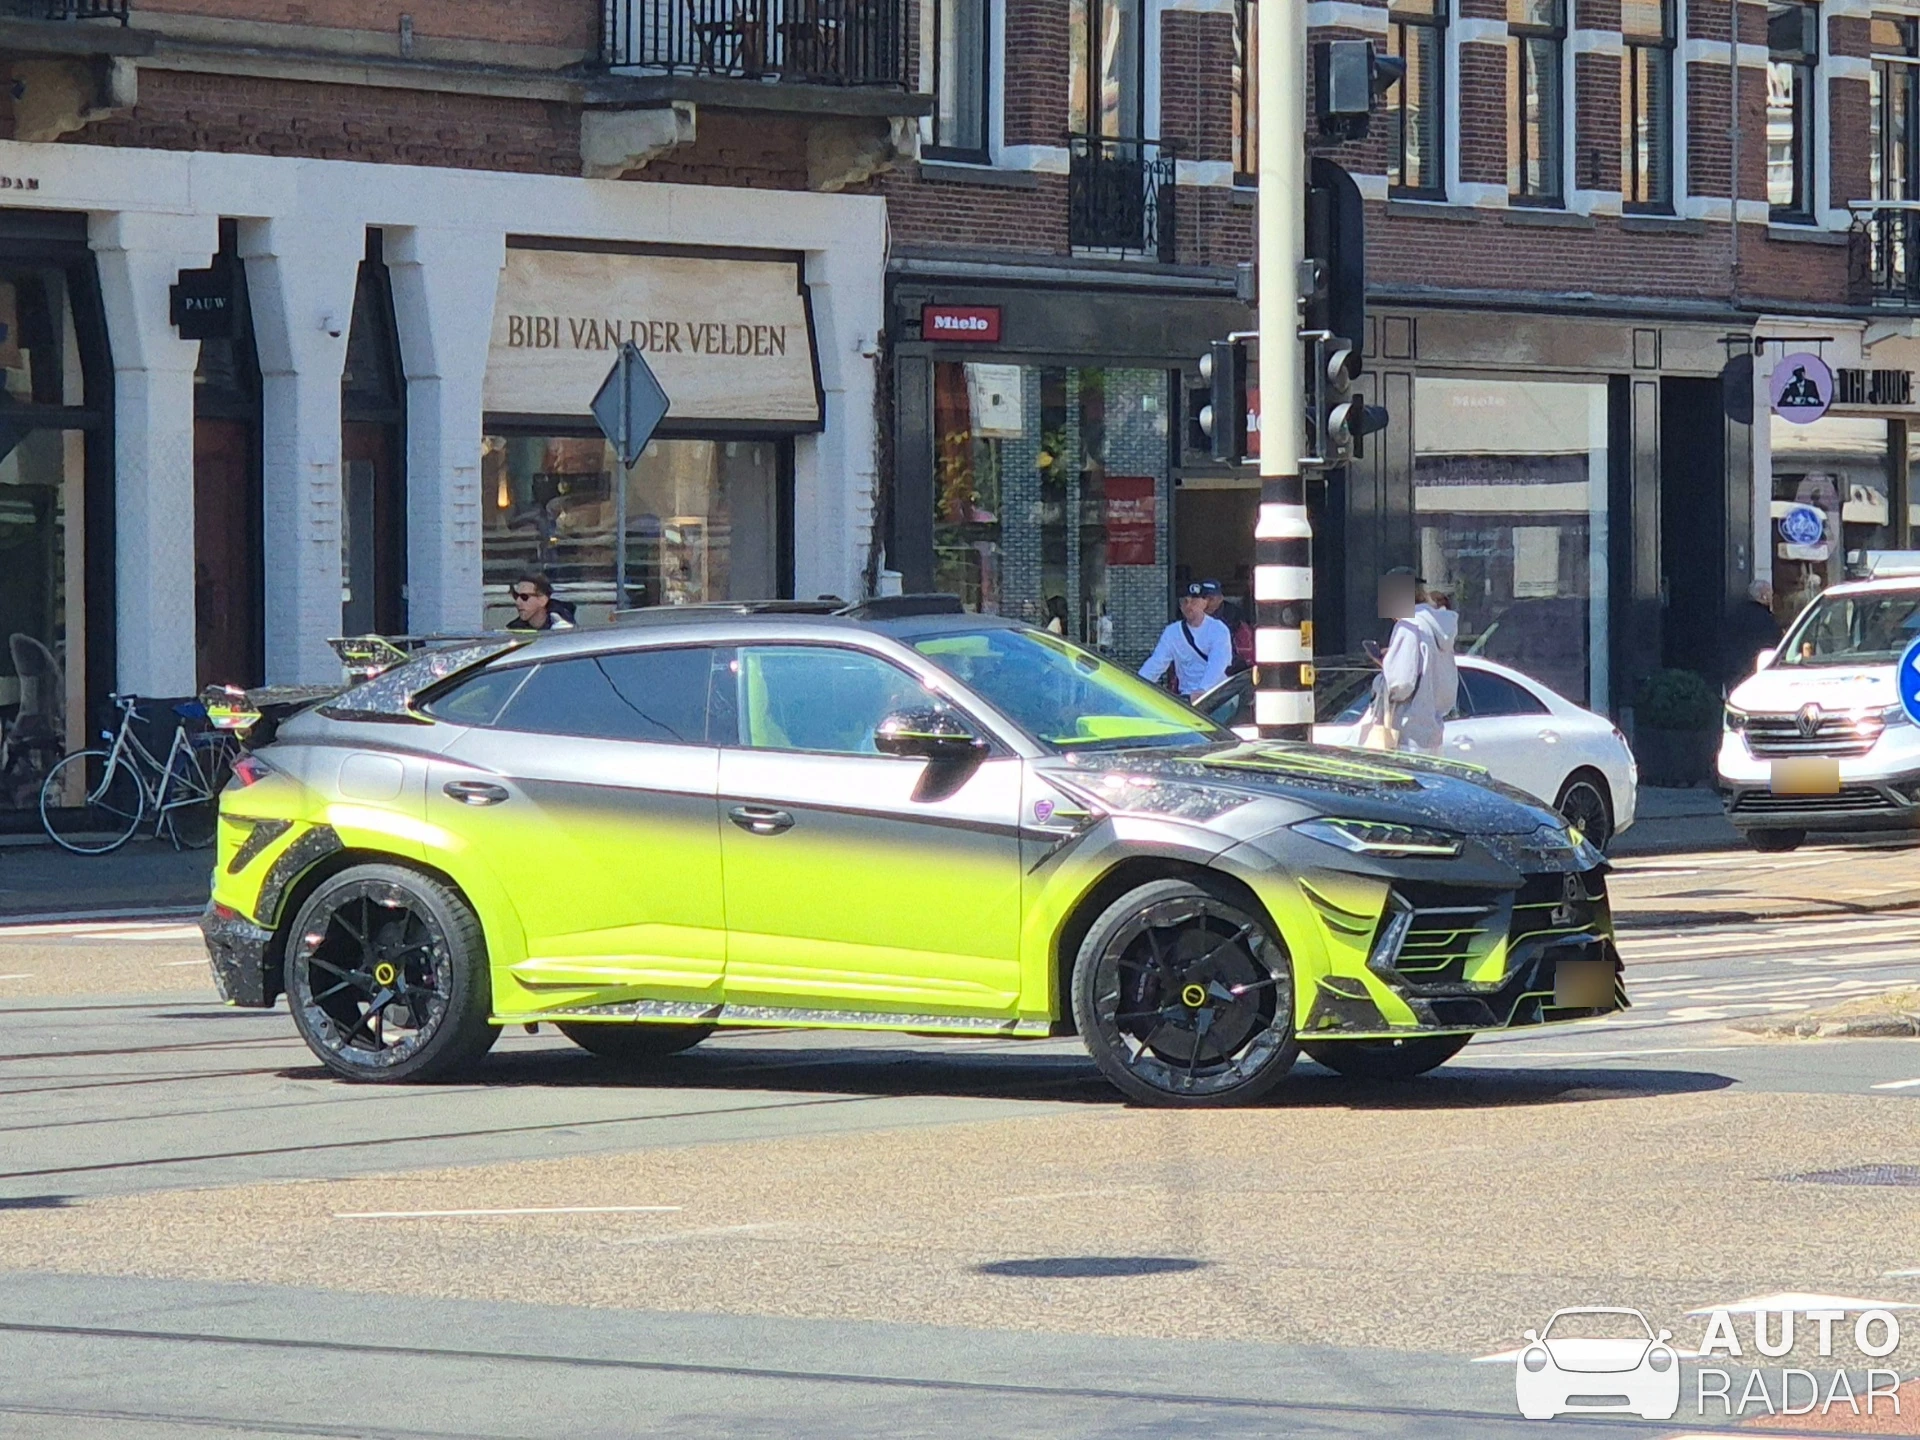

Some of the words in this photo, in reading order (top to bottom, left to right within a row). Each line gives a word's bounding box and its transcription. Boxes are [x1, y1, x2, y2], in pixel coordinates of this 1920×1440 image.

[186, 297, 226, 310] PAUW
[934, 315, 988, 330] Miele
[508, 315, 558, 348] BIBI
[569, 318, 622, 351] VAN
[631, 320, 682, 353] DER
[687, 322, 786, 357] VELDEN
[1869, 369, 1915, 405] JUICE
